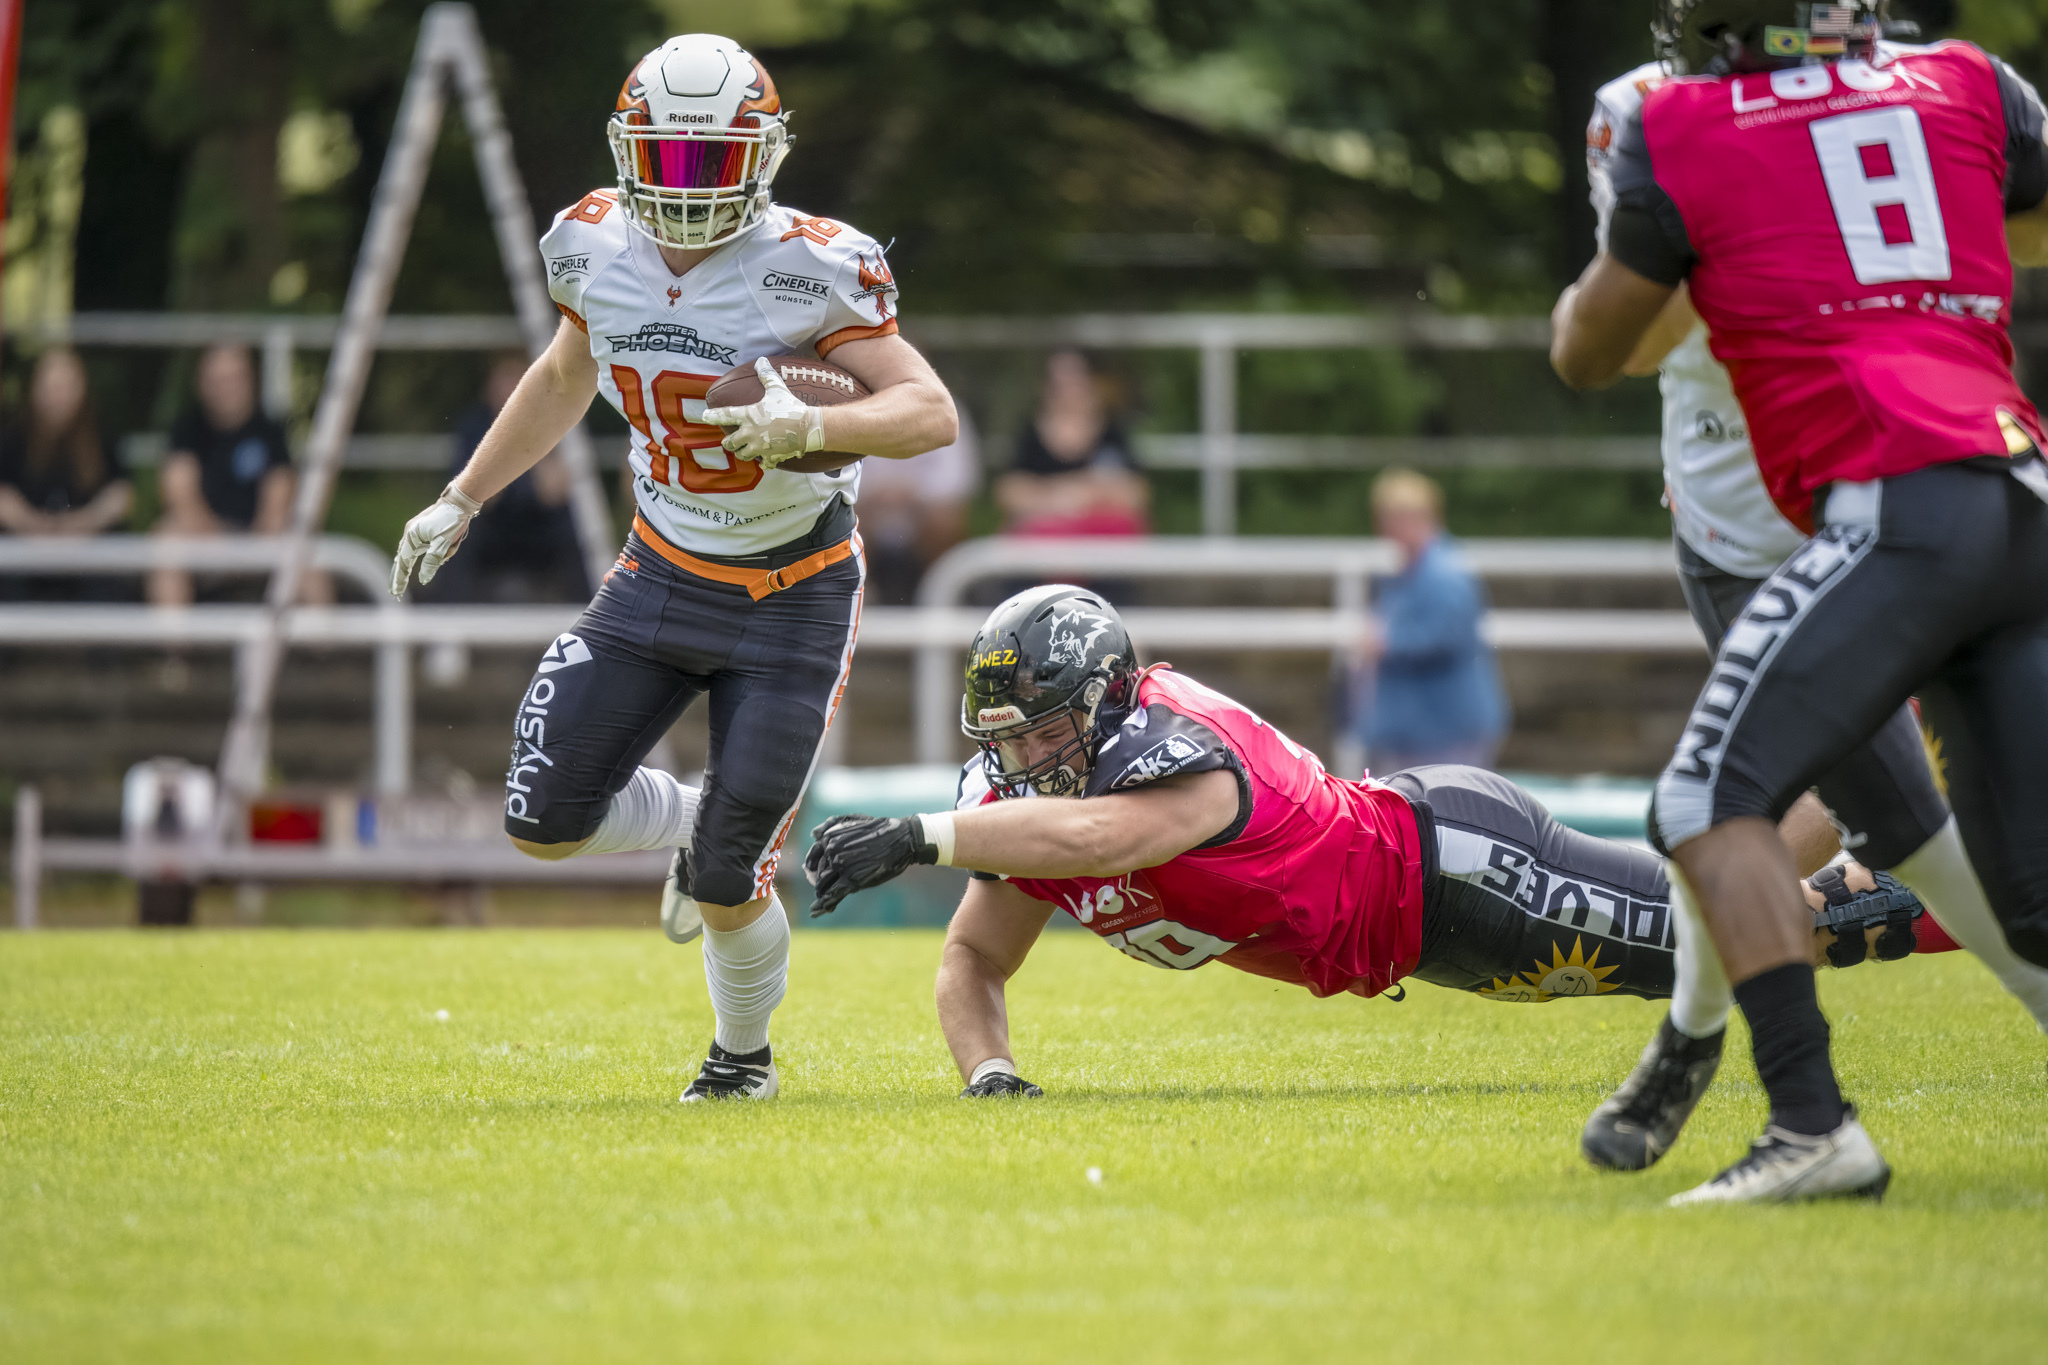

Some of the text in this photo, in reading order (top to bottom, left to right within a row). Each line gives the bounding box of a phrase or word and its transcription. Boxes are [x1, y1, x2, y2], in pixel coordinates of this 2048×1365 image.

[668, 112, 713, 124] Riddell
[1808, 104, 1952, 286] 8
[551, 258, 589, 277] CINEPLEX
[762, 272, 830, 297] CINEPLEX
[775, 294, 813, 306] MÜNSTER
[640, 322, 698, 338] MÜNSTER
[604, 333, 738, 367] PHOENIX
[609, 363, 765, 494] 18
[712, 511, 722, 524] &
[980, 711, 1015, 723] Riddell
[507, 678, 556, 824] physio
[1479, 842, 1677, 950] OLVES
